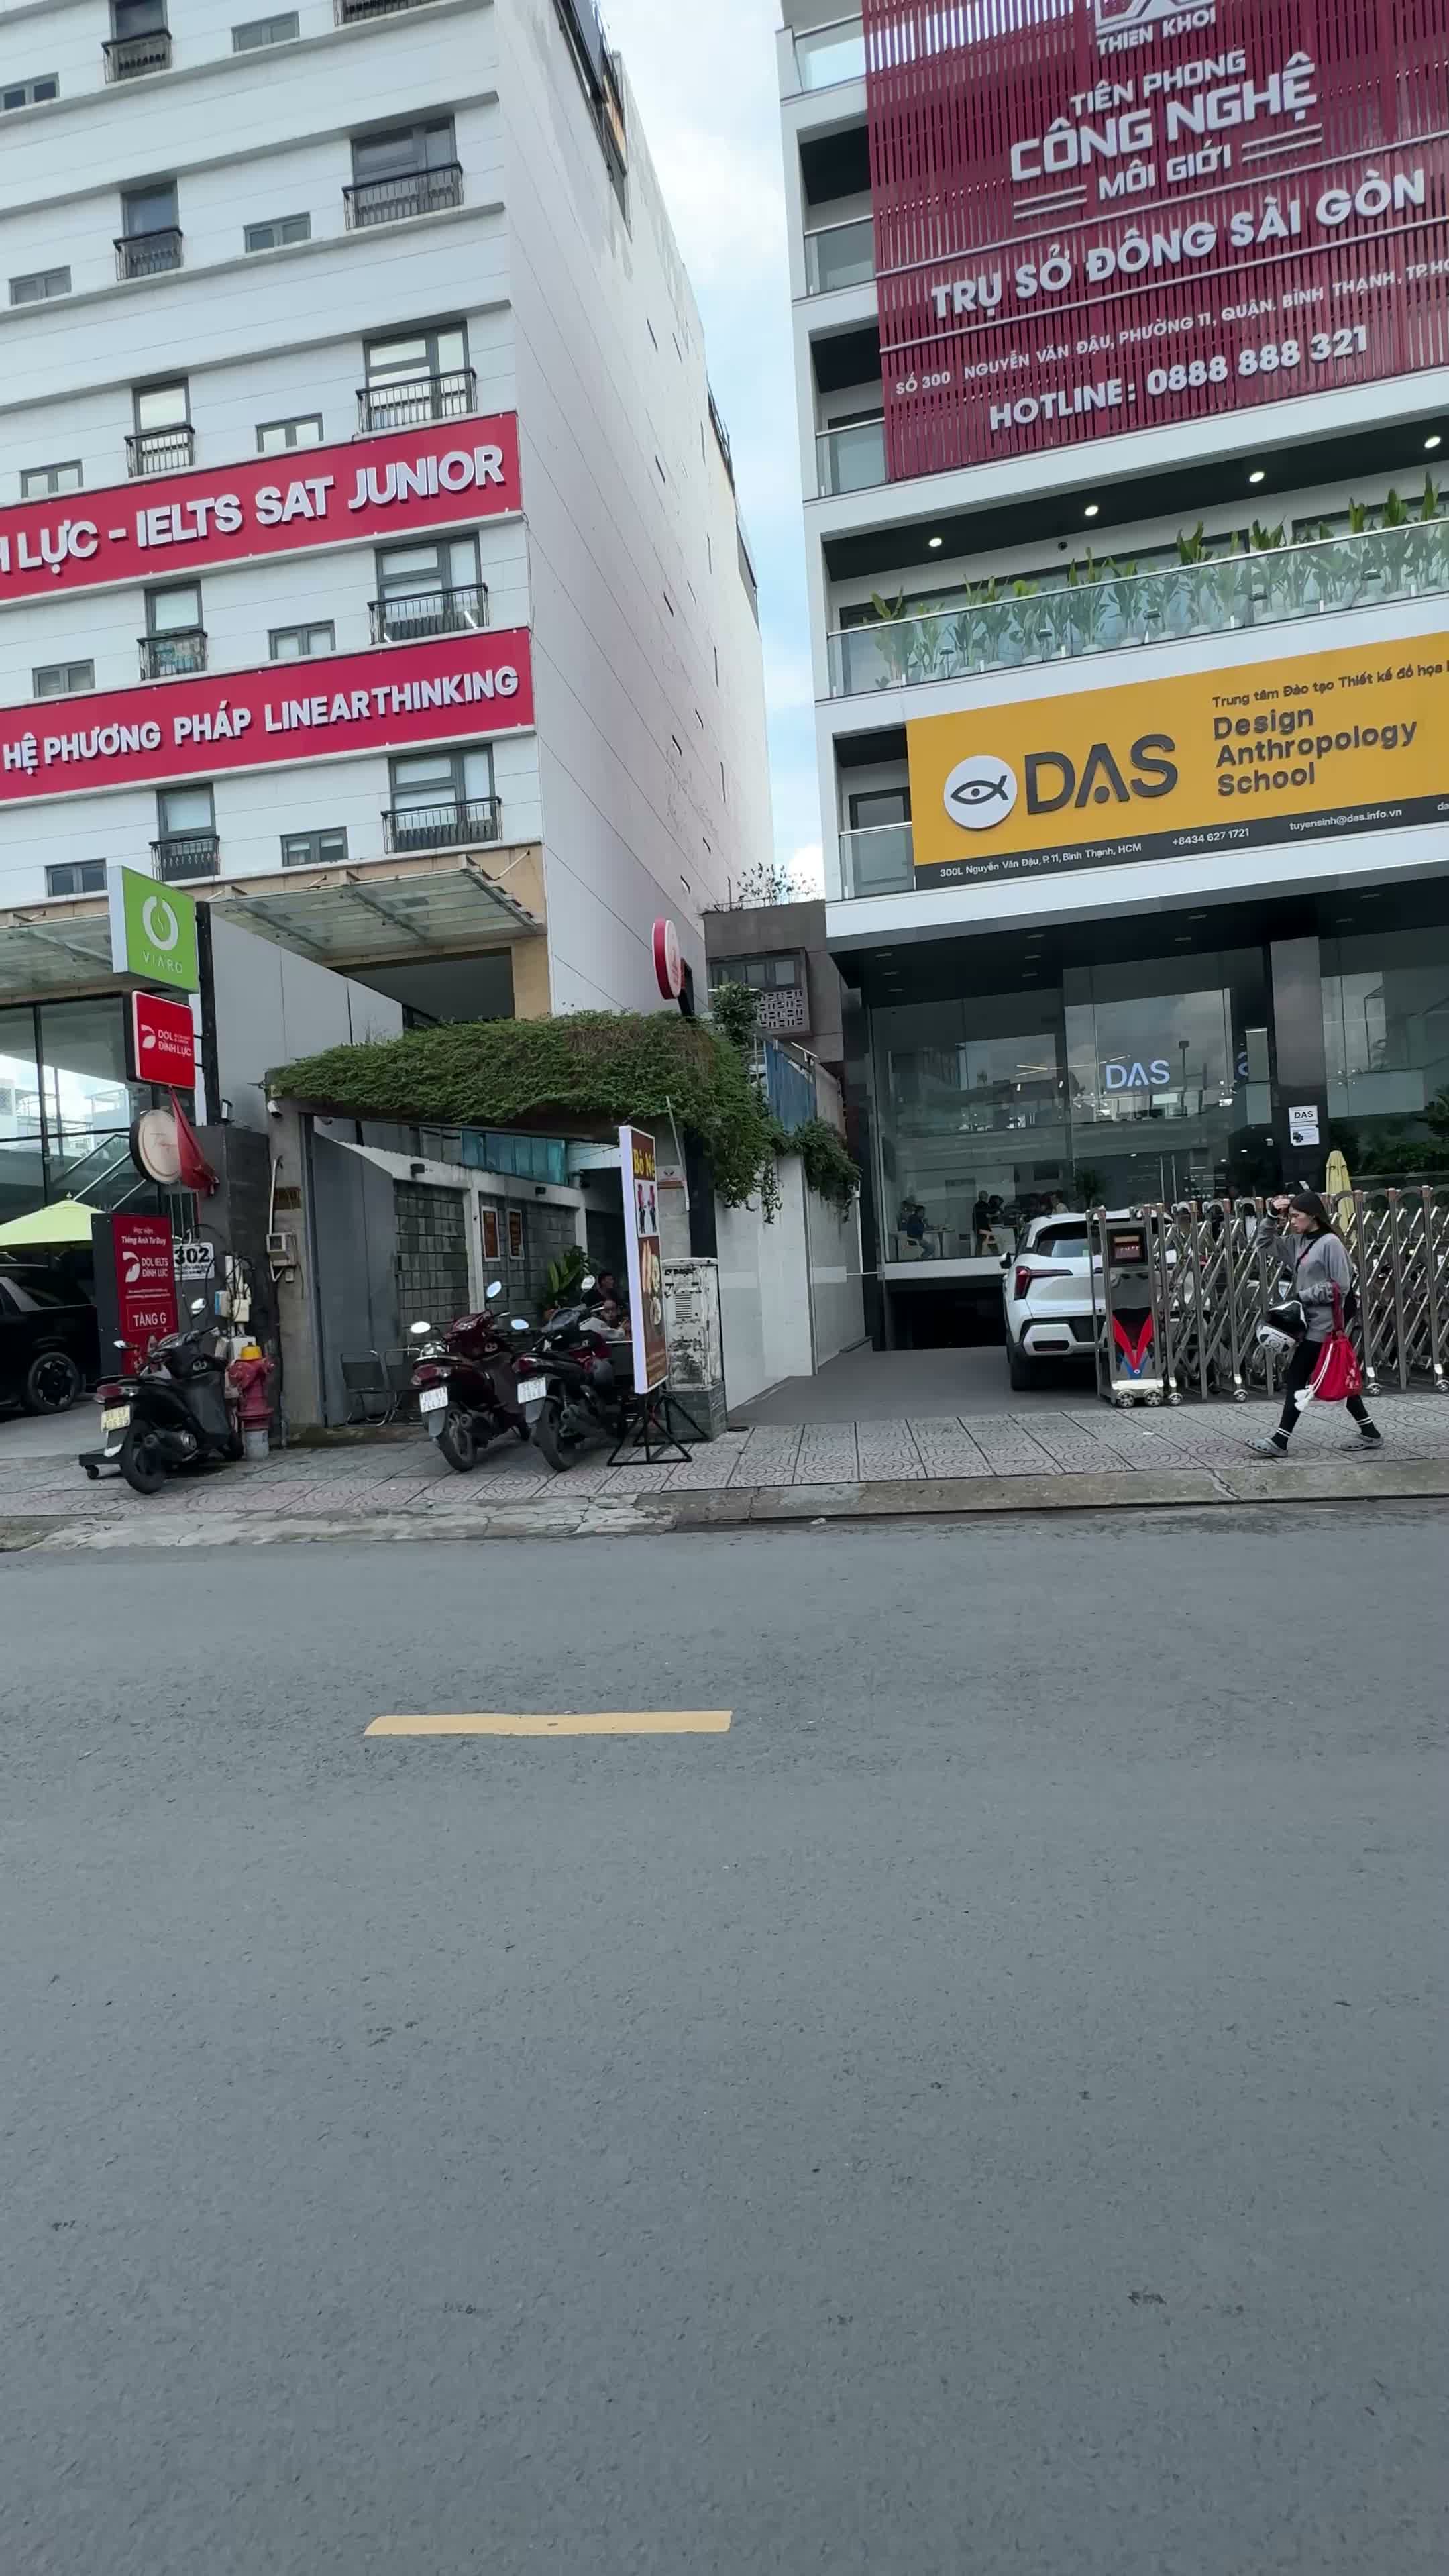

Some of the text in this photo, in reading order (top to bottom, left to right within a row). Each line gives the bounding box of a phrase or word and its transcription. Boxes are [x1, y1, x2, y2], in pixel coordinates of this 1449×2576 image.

[1143, 49, 1246, 98] PHONG
[1010, 51, 1317, 182] CÔNG NGHỆ
[1099, 139, 1232, 201] MÔI GIỚI
[932, 168, 1425, 321] TRỤ SỞ ĐÔNG SÀI GÒN
[896, 372, 918, 395] SỐ
[922, 371, 951, 390] 300
[964, 350, 1030, 380] NGUYỄN
[1076, 335, 1114, 356] ĐẬU,
[1119, 318, 1193, 345] PHƯỜNG
[1282, 287, 1324, 309] BÌNH
[1147, 356, 1228, 396] 0888
[1238, 340, 1301, 376] 888
[1310, 325, 1367, 360] 321
[17, 519, 98, 574] LỰC
[136, 494, 242, 547] IELTS
[256, 476, 334, 525] SAT
[348, 445, 504, 510] JUNIOR
[1212, 694, 1250, 708] Trung
[1254, 690, 1279, 702] tâm
[1283, 684, 1309, 697] Đào
[1312, 680, 1334, 694] tạo
[1338, 674, 1373, 688] Thiết
[3, 732, 38, 775] HỆ
[44, 721, 160, 764] PHƯƠNG
[174, 700, 251, 745] PHÁP
[1213, 708, 1314, 741] Design
[1216, 721, 1417, 768] Anthropology
[1024, 733, 1178, 814] DAS
[1218, 761, 1315, 797] School
[1172, 828, 1249, 845] +8434 627 1721
[1289, 808, 1402, 831] tuyensinh@das.info.vn
[939, 867, 963, 878] 300L
[1118, 843, 1142, 854] HCM
[158, 1029, 174, 1042] DOL
[1106, 1059, 1170, 1089] DAS
[1295, 1110, 1313, 1118] DAS
[142, 1257, 154, 1267] DOL
[175, 1247, 209, 1265] 302
